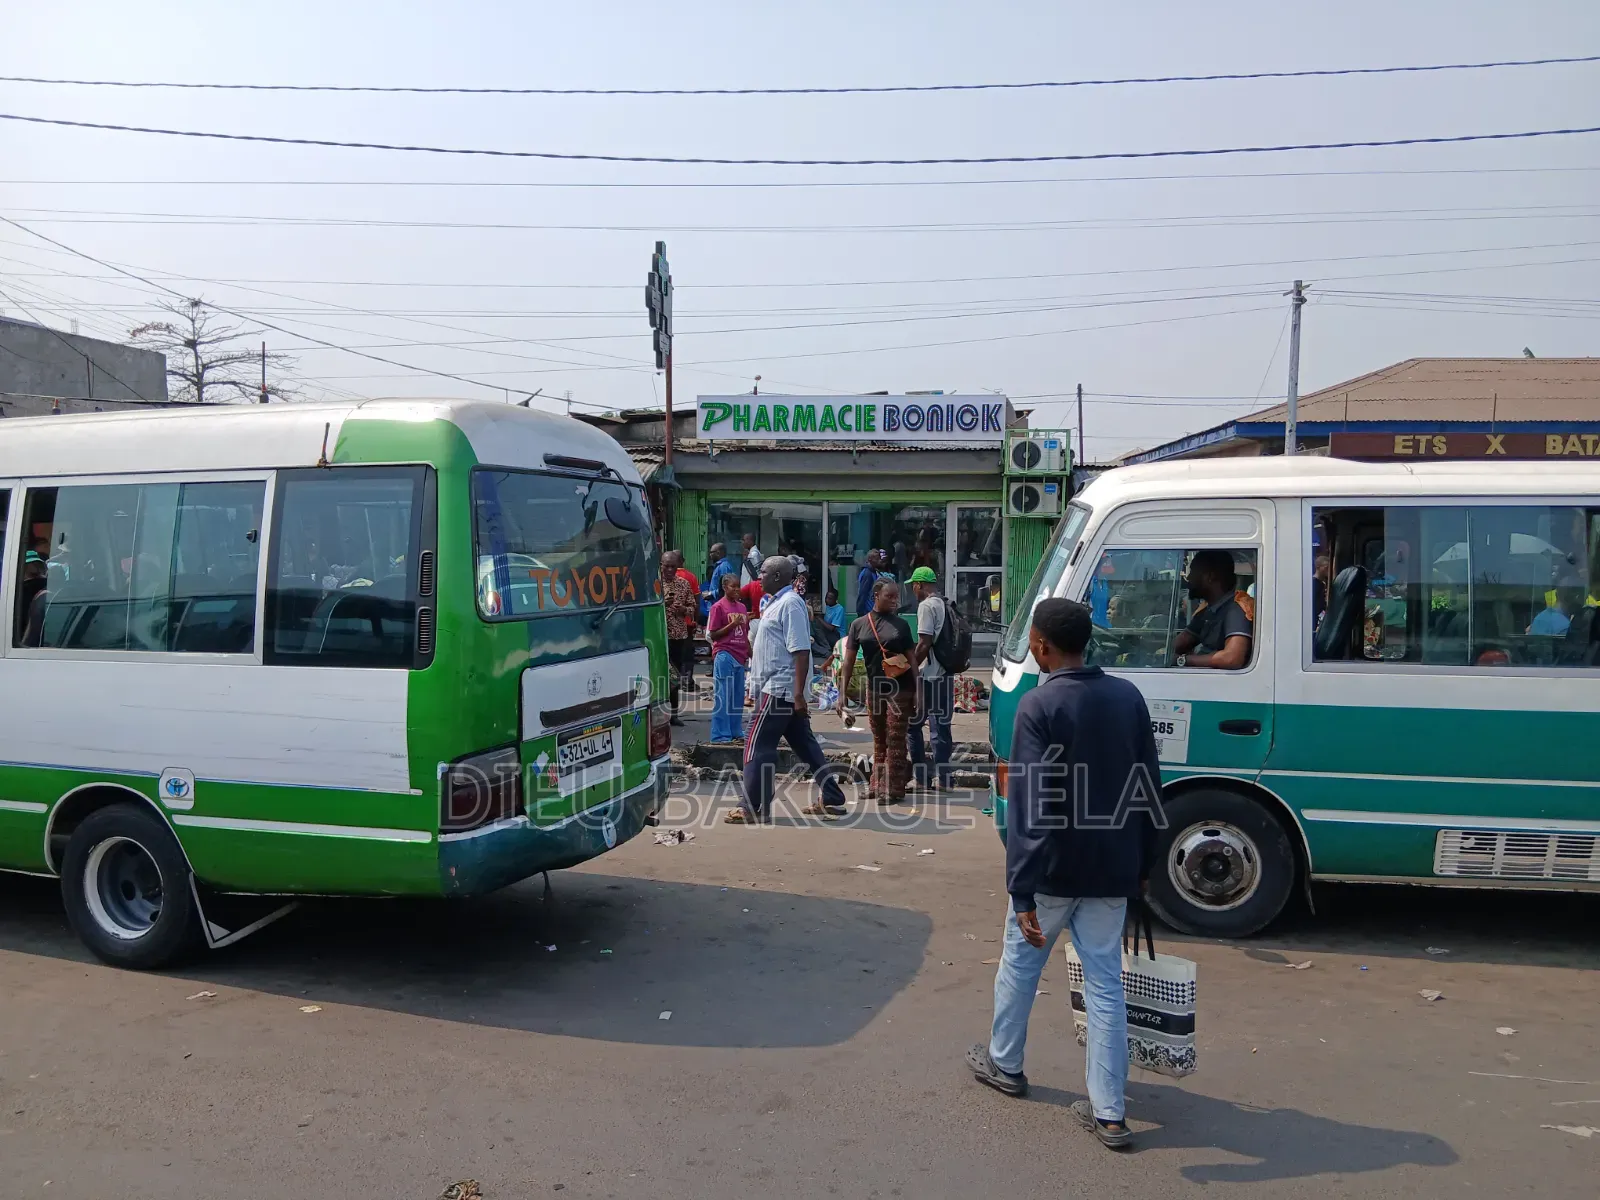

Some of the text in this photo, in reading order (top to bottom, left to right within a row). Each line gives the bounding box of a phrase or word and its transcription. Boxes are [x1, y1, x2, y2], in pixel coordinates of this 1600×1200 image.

[700, 402, 1003, 432] PHARMACIE BONICK
[1394, 434, 1600, 456] ETS X BAT
[528, 566, 636, 610] TOYOTA
[1127, 1010, 1162, 1024] OUNTER
